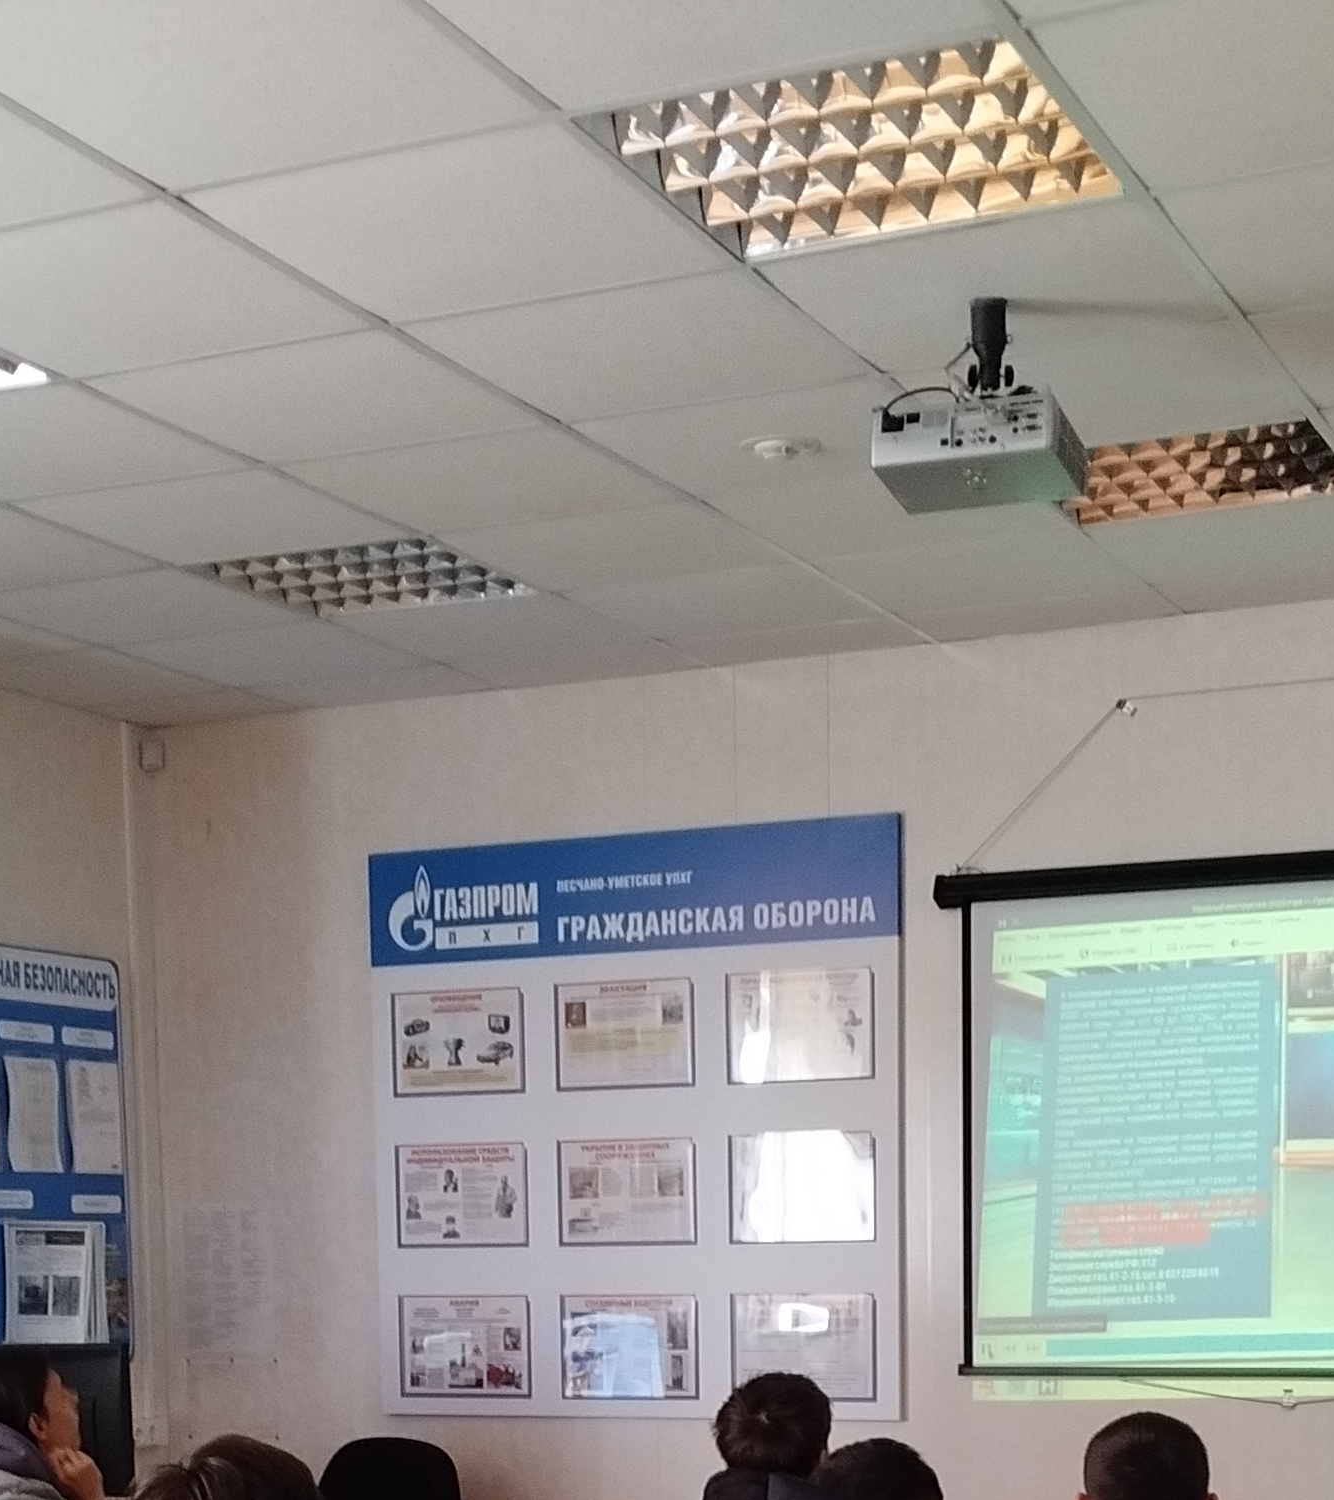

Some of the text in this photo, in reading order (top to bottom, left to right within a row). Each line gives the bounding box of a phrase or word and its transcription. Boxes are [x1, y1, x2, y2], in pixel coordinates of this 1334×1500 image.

[556, 870, 694, 893] ПЕСЧАНО-УМЕТСКОЕ УПХГ
[433, 882, 539, 921] ГАЗПРОМ
[556, 896, 876, 943] ГРАЖДАНСКАЯ ОБОРОНА
[23, 962, 116, 1000] БЕЗОПАСНОСТЬ
